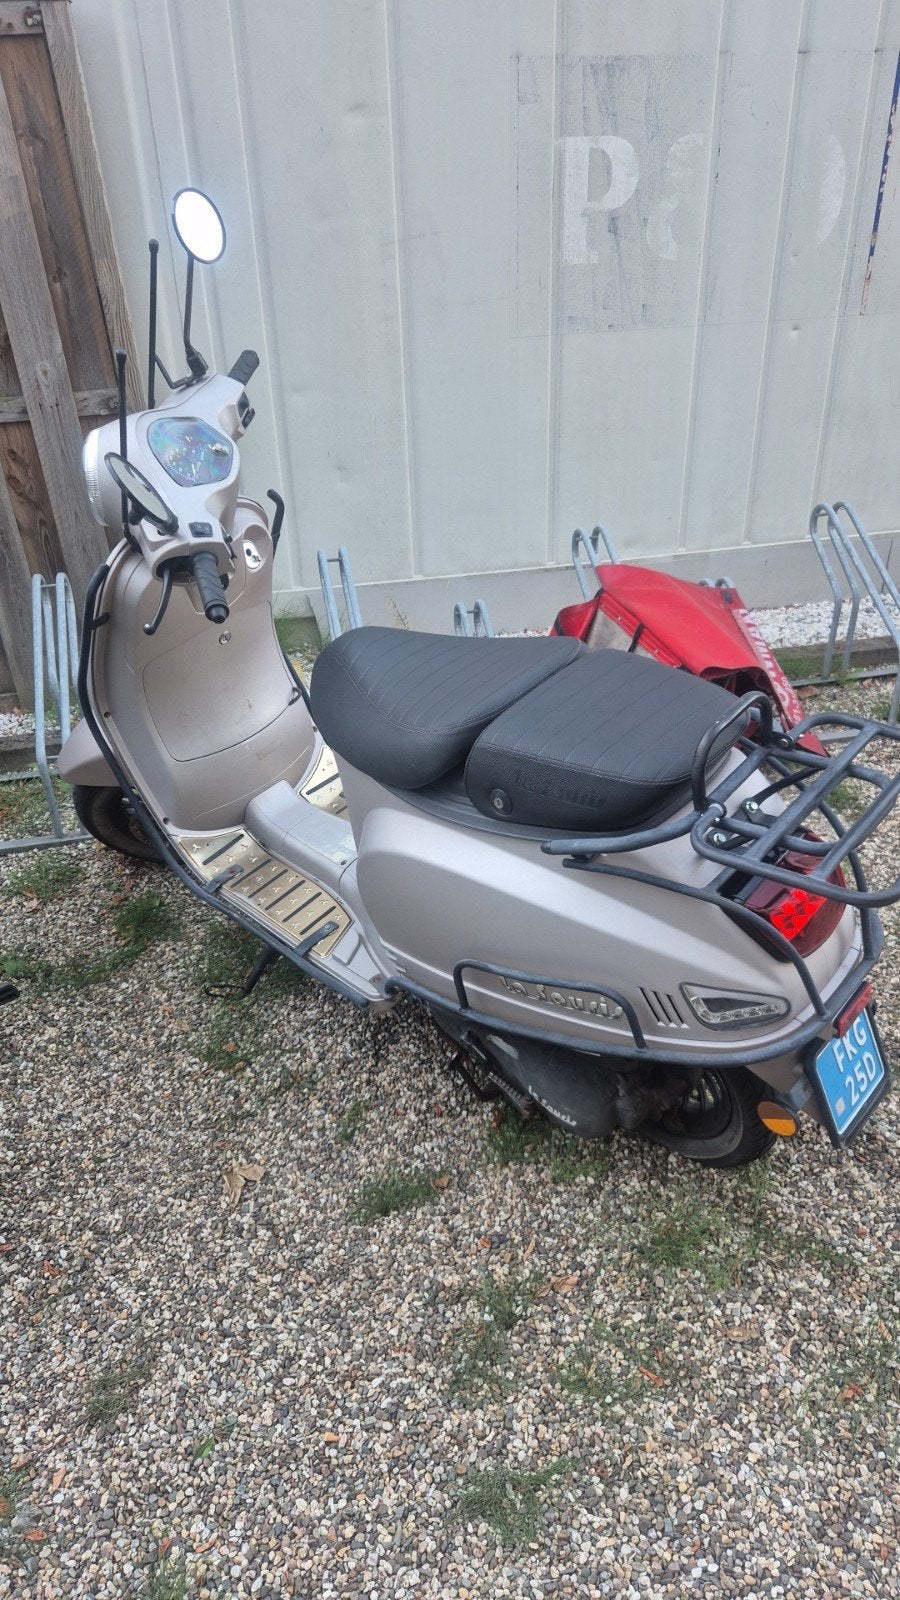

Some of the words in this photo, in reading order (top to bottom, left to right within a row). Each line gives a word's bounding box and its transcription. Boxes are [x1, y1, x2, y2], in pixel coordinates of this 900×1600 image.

[535, 984, 623, 1020] Souris
[832, 1015, 868, 1074] FKG
[844, 1051, 877, 1106] 25D
